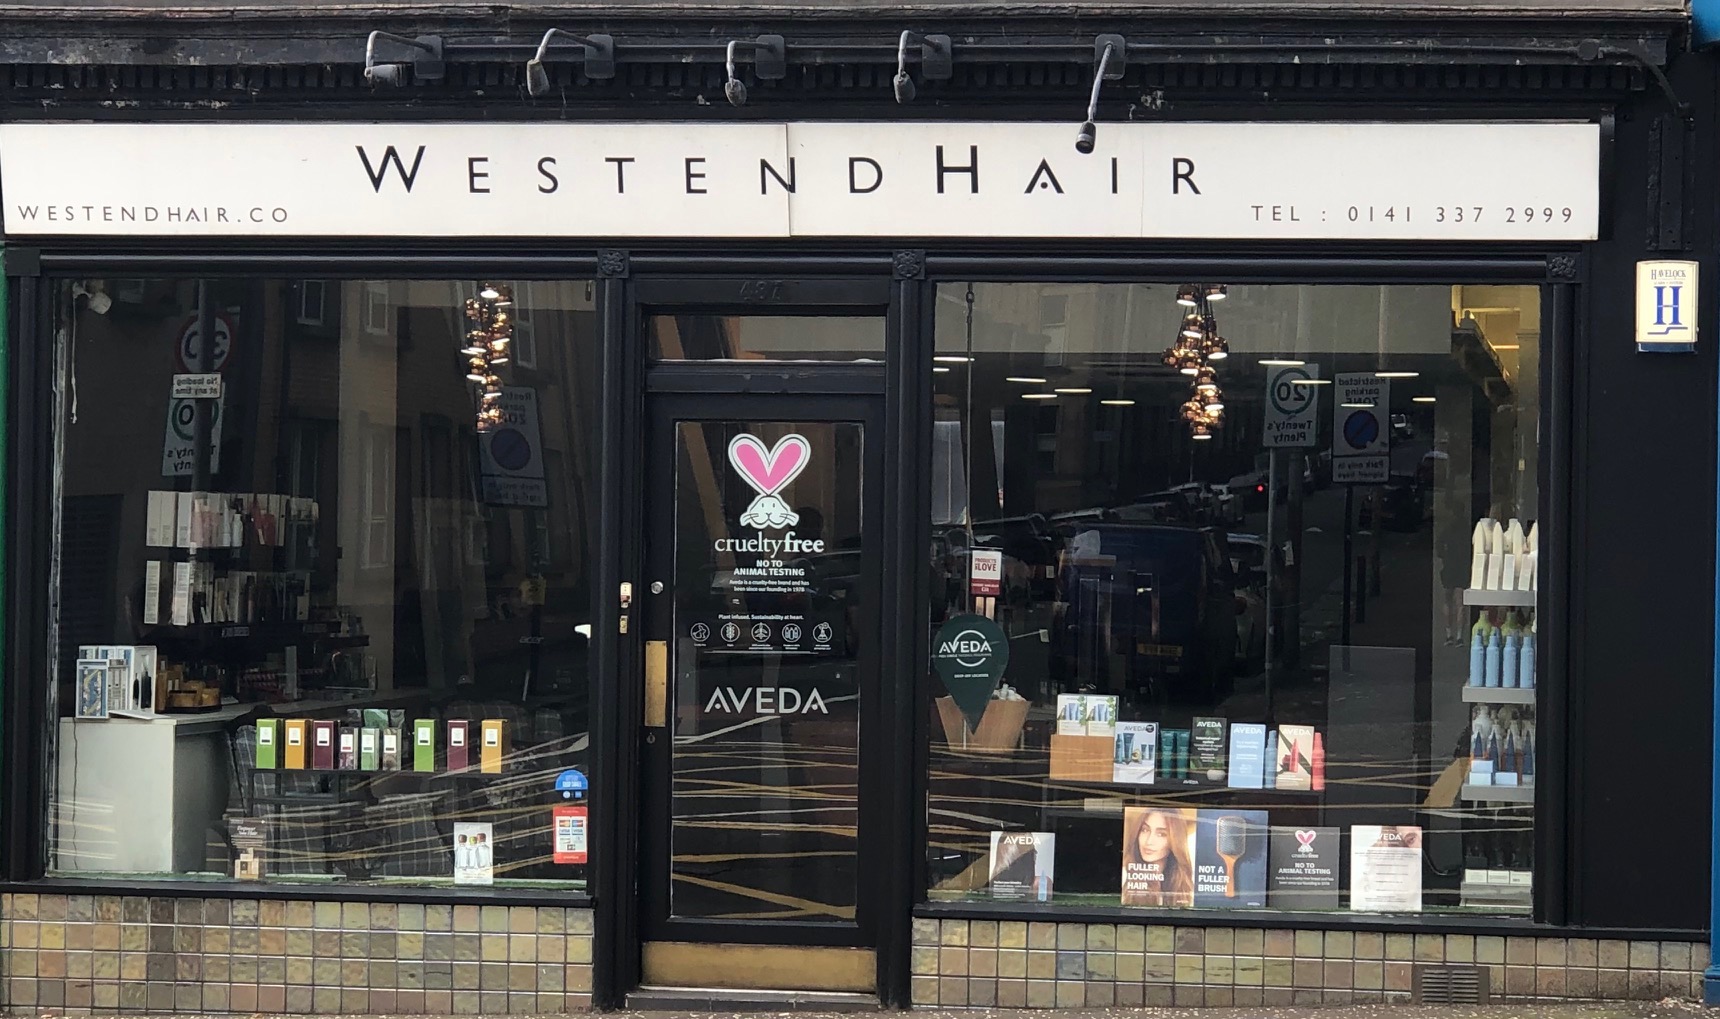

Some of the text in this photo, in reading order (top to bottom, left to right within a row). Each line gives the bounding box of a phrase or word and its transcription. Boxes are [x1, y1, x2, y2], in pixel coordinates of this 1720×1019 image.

[18, 206, 288, 223] WESTENDHAIR.CO
[1252, 205, 1300, 222] TEL
[1348, 206, 1410, 222] 0141
[1436, 206, 1483, 223] 337
[1505, 207, 1574, 223] 2999
[1651, 269, 1686, 280] HAVELOCK
[734, 568, 805, 576] ANIMAL TESTING
[939, 640, 992, 654] AVEDA
[704, 686, 829, 714] AVEDA
[1233, 727, 1262, 735] AVEDA
[1282, 728, 1311, 736] AVEDA
[1003, 836, 1041, 845] AVEDA
[1128, 863, 1160, 872] FULLER
[1198, 865, 1224, 874] NOT A
[1127, 872, 1164, 881] LOOKING
[1198, 874, 1230, 883] FULLER
[1127, 882, 1148, 890] HAIR
[1198, 884, 1228, 892] BRUSH
